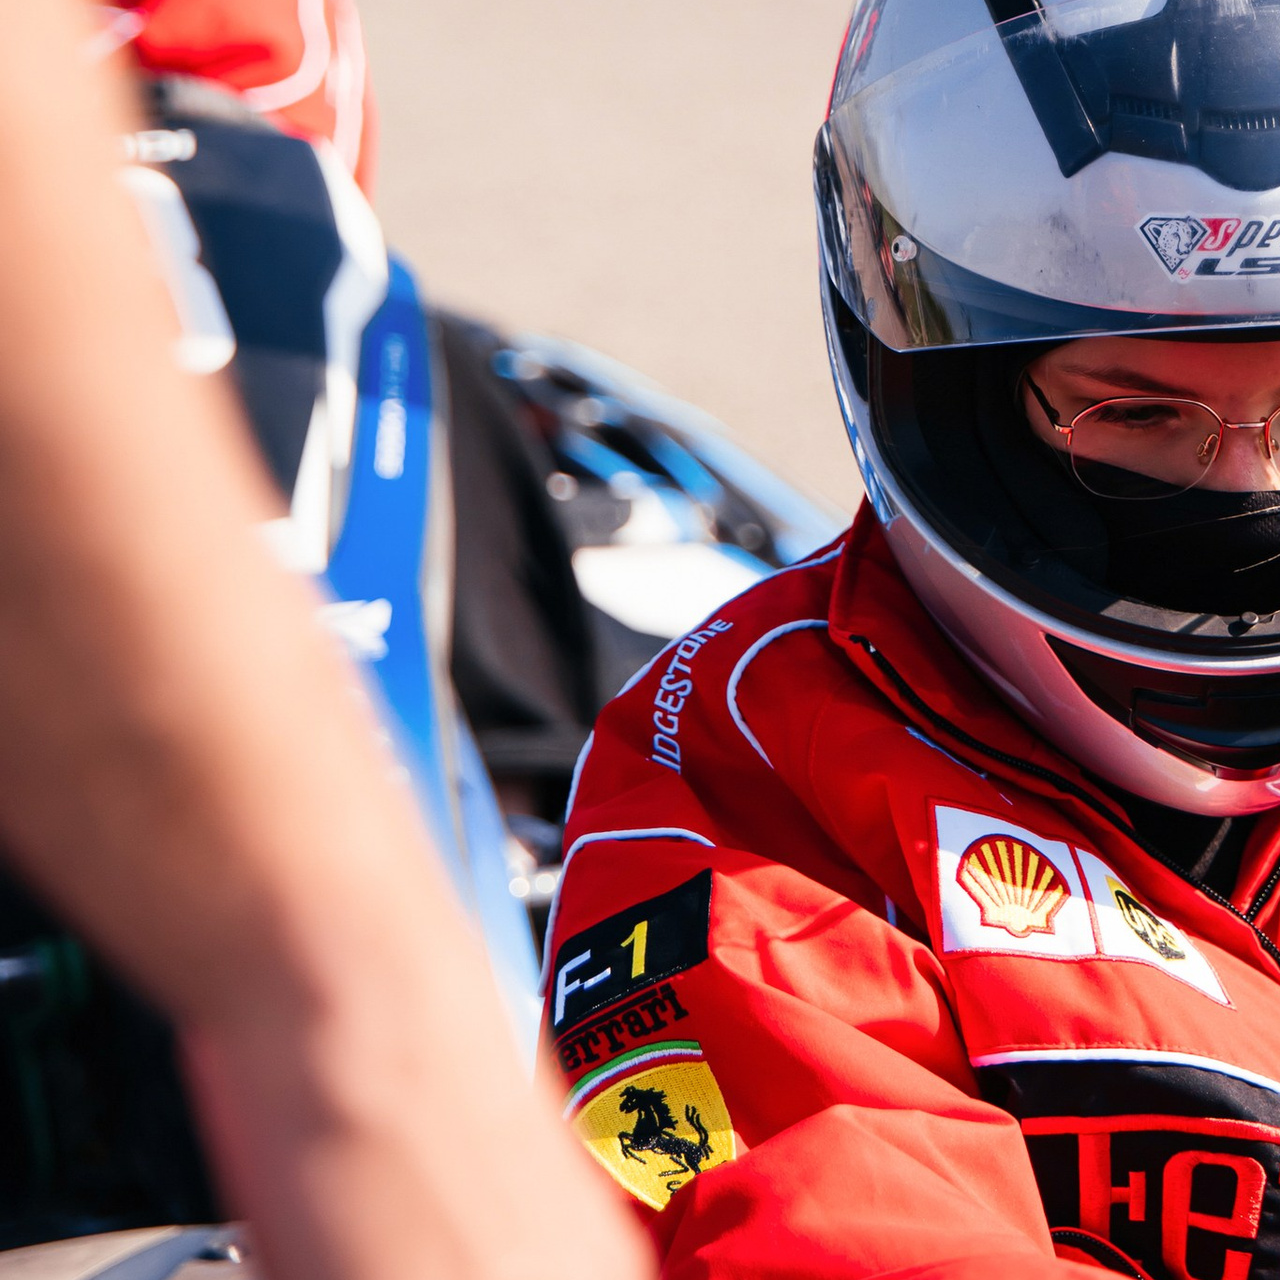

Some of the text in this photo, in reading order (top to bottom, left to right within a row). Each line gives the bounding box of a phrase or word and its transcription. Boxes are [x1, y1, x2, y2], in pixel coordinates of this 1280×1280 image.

[1178, 267, 1191, 280] by
[652, 618, 734, 776] IDGESTONE
[553, 982, 690, 1073] errari
